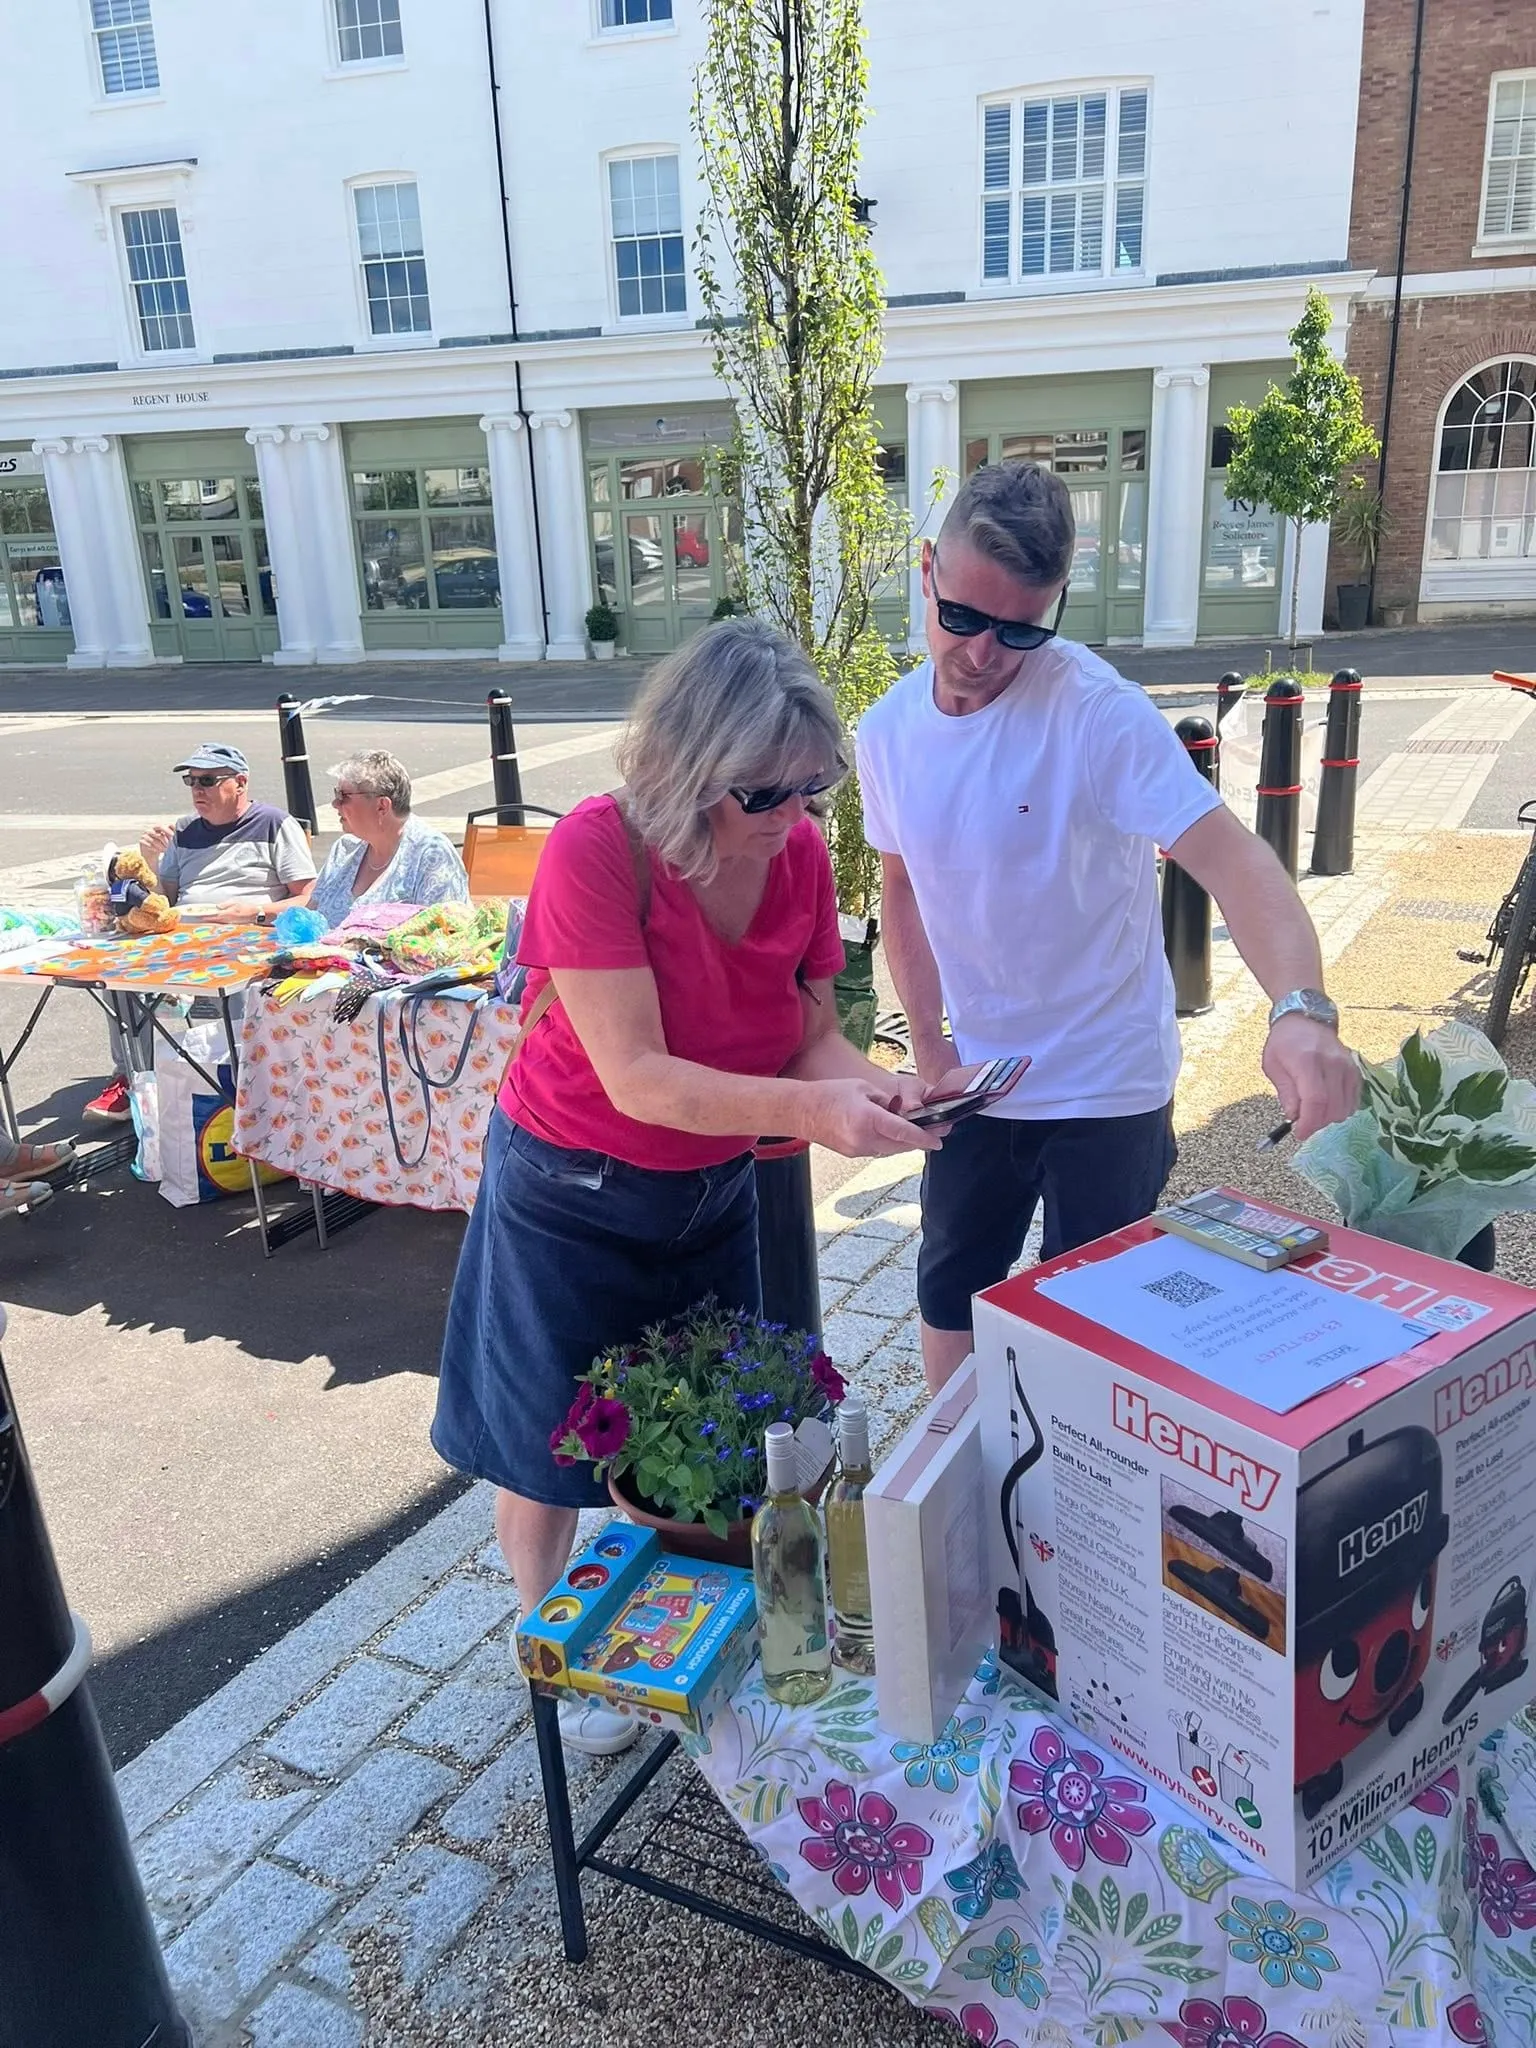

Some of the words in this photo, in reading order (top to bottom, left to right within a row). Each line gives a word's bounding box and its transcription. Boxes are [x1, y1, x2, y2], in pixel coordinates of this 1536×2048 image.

[132, 394, 170, 406] REGENT
[175, 391, 209, 404] HOUSE
[1223, 531, 1266, 540] Solicitors
[1247, 519, 1275, 529] James
[1253, 1340, 1302, 1363] TICKET
[1305, 1343, 1357, 1368] RAFFLE
[1435, 1341, 1536, 1434] Henry
[1051, 1414, 1086, 1444] Perfect
[1089, 1435, 1148, 1479] All-rounder
[1053, 1444, 1073, 1466] Built
[1077, 1459, 1086, 1473] to
[1089, 1465, 1111, 1488] Last
[1112, 1381, 1281, 1512] Henry
[1054, 1486, 1078, 1512] Huge
[1080, 1501, 1120, 1538] Capacity
[1339, 1490, 1428, 1578] Henry
[1056, 1516, 1093, 1549] Powerful
[1095, 1540, 1136, 1578] Cleaning
[1057, 1544, 1082, 1569] Made
[1084, 1561, 1091, 1575] in
[1093, 1568, 1108, 1586] the
[726, 1588, 749, 1615] COUNT
[1058, 1572, 1086, 1601] Stores
[1088, 1592, 1116, 1622] Neatly
[1162, 1604, 1181, 1627] and
[708, 1616, 731, 1637] WITH
[1059, 1600, 1082, 1626] Great
[1084, 1616, 1124, 1654] Features
[1161, 1590, 1198, 1625] Perfect
[1201, 1615, 1215, 1634] for
[1217, 1623, 1262, 1665] Carpets
[686, 1638, 715, 1670] DOUGH
[1163, 1639, 1211, 1684] Emptying
[1214, 1672, 1236, 1699] with
[1239, 1688, 1255, 1710] No
[1163, 1652, 1186, 1679] Dust
[1189, 1669, 1210, 1694] and
[1212, 1684, 1228, 1705] No
[1231, 1696, 1262, 1728] Mess
[1109, 1734, 1268, 1858] www.myhenry.com
[1307, 1825, 1332, 1861] 10
[1339, 1771, 1405, 1837] Million
[1411, 1712, 1478, 1778] Henrys
[1339, 1786, 1363, 1812] made
[1366, 1770, 1383, 1791] over
[1305, 1856, 1323, 1879] and
[1324, 1836, 1347, 1864] most
[1349, 1826, 1359, 1844] of
[1360, 1808, 1381, 1834] them
[1383, 1796, 1396, 1815] are
